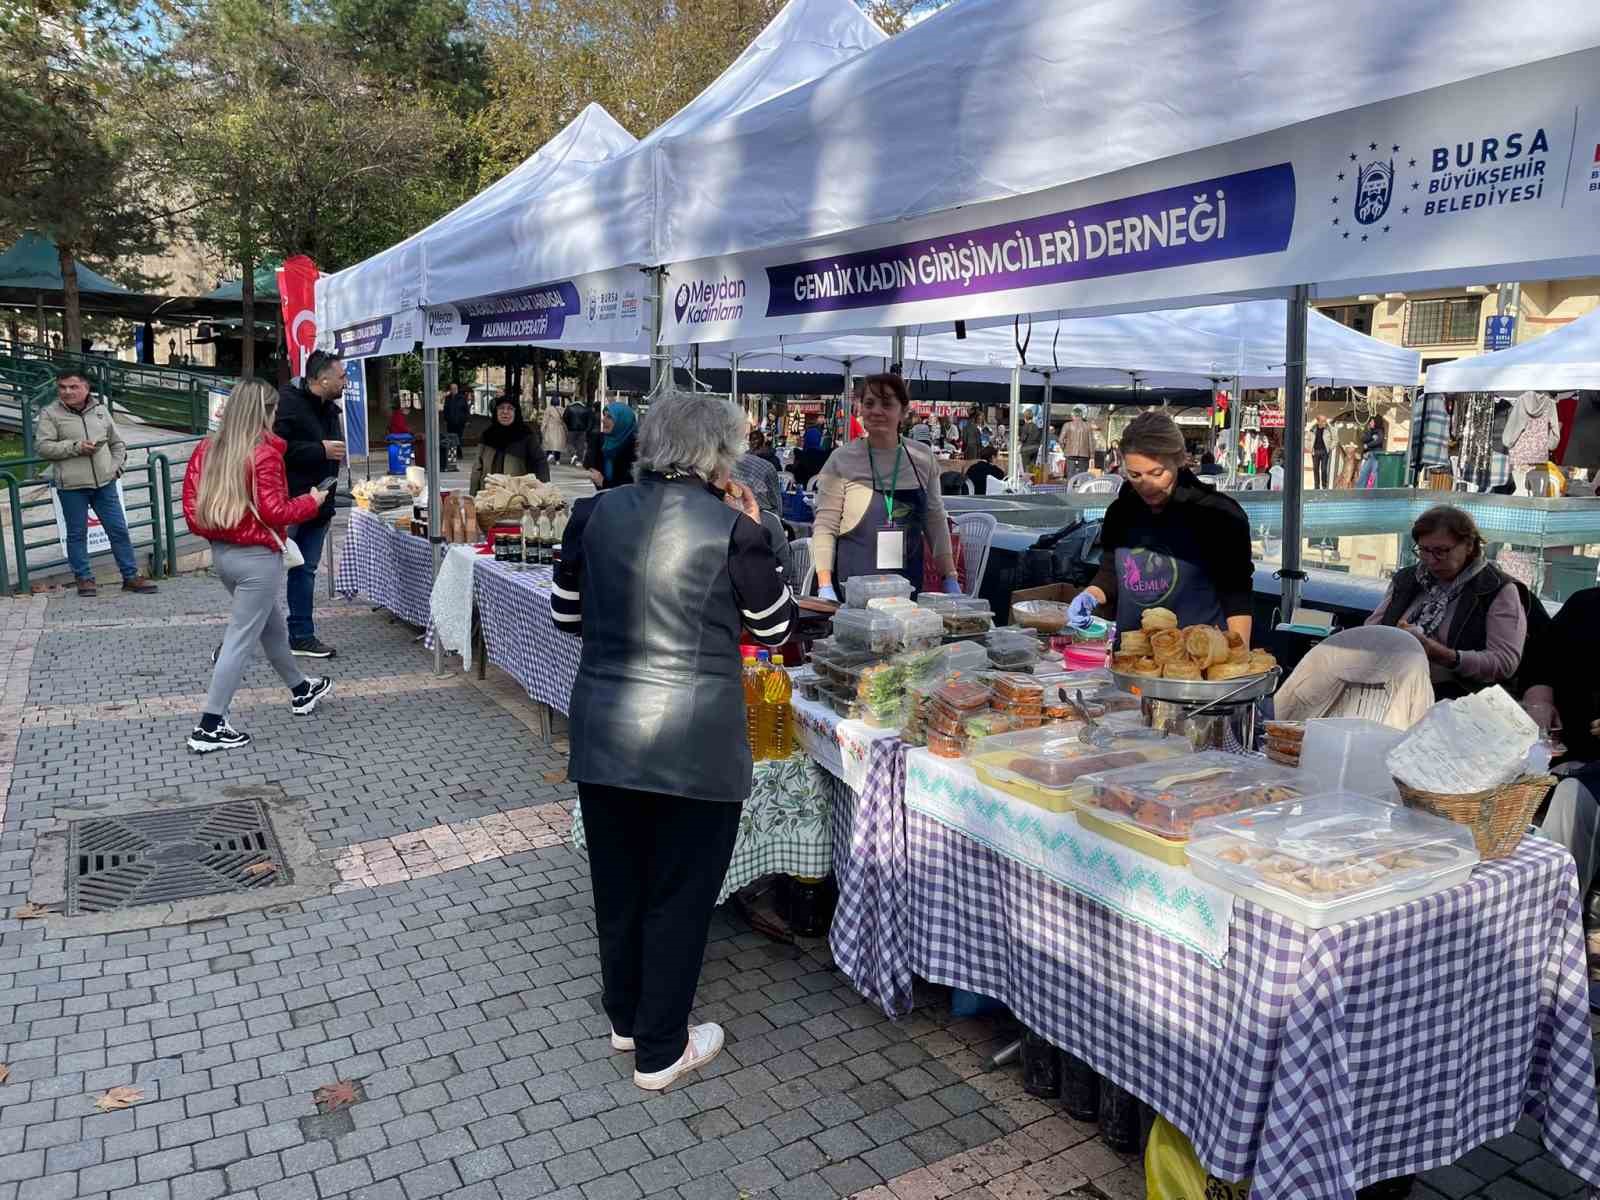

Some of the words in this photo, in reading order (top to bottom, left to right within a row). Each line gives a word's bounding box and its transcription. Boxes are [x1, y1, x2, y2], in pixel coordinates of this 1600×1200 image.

[1431, 128, 1549, 173] BURSA
[1428, 157, 1546, 194] BÜYÜKŞEHİR
[1423, 178, 1545, 216] BELEDİYESİ
[794, 263, 856, 301] GEMLİK
[855, 257, 917, 293] KADIN
[918, 219, 1080, 287] GİRİŞİMCİLERİ
[1084, 189, 1226, 260] DERNEĞİ
[691, 275, 746, 306] Meydan
